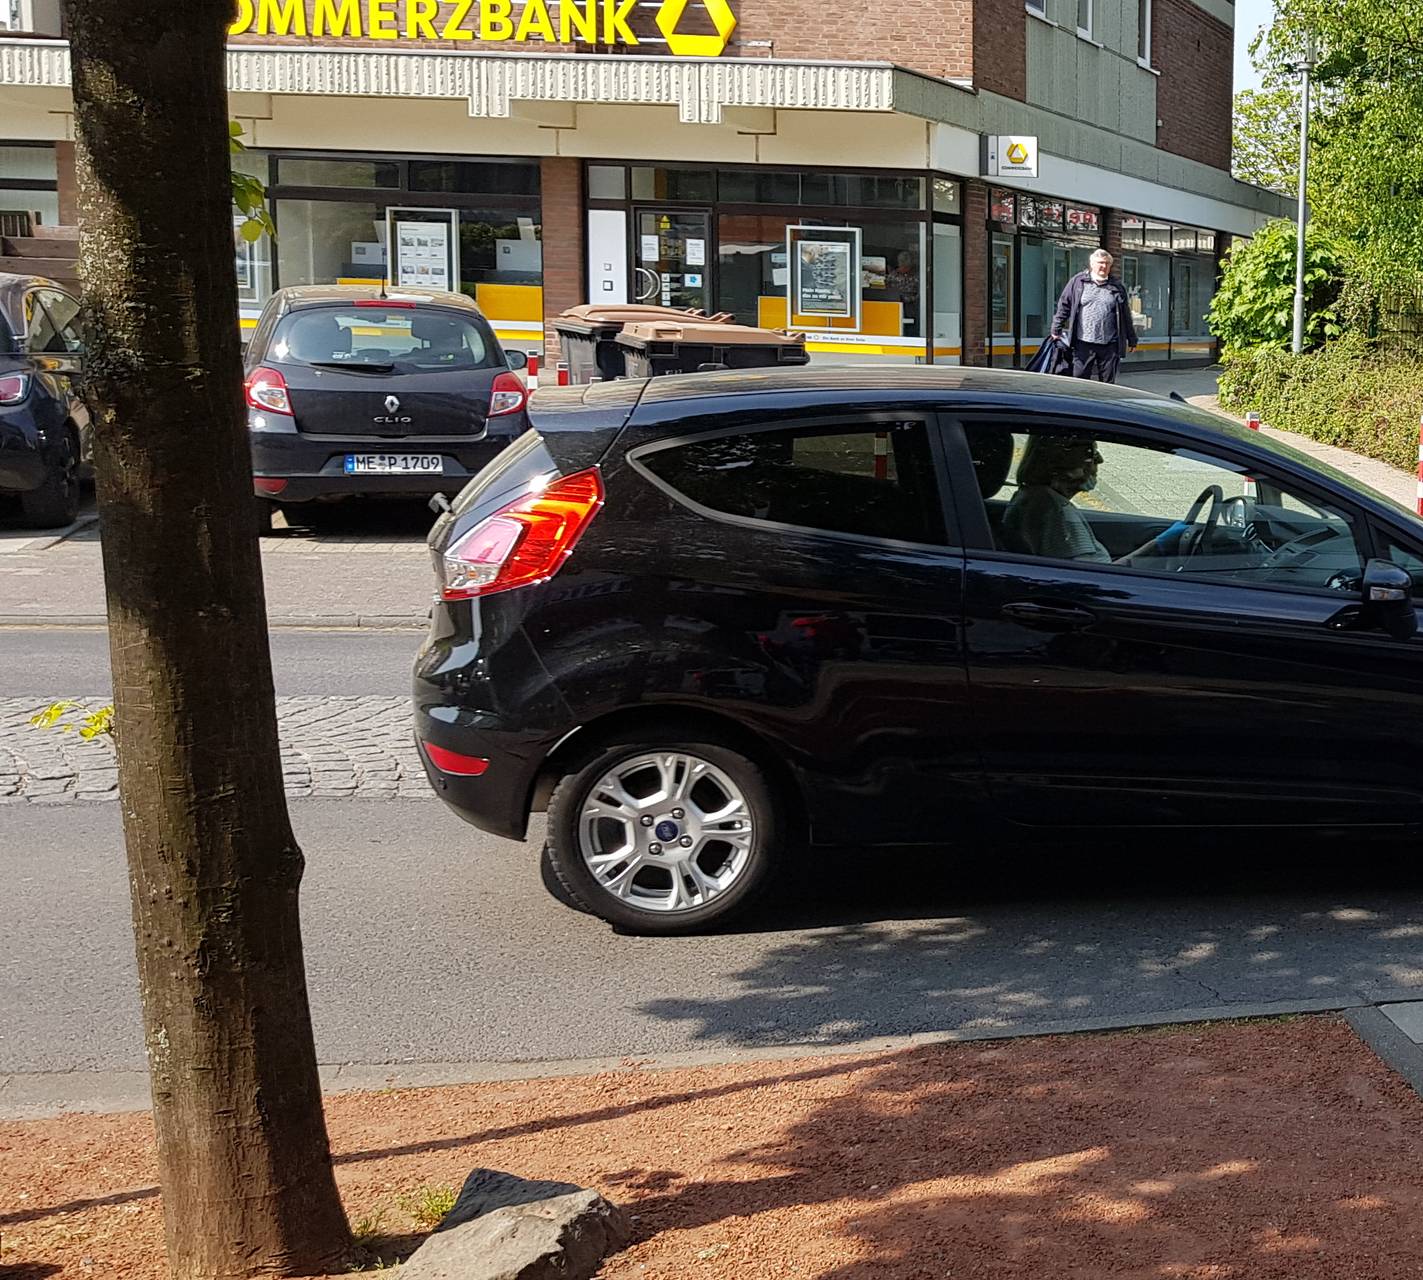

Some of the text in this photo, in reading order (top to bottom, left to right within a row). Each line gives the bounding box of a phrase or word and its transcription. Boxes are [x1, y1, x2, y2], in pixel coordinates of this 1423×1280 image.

[227, 0, 640, 45] OMMERZBANK
[356, 456, 440, 470] ME P 1709
